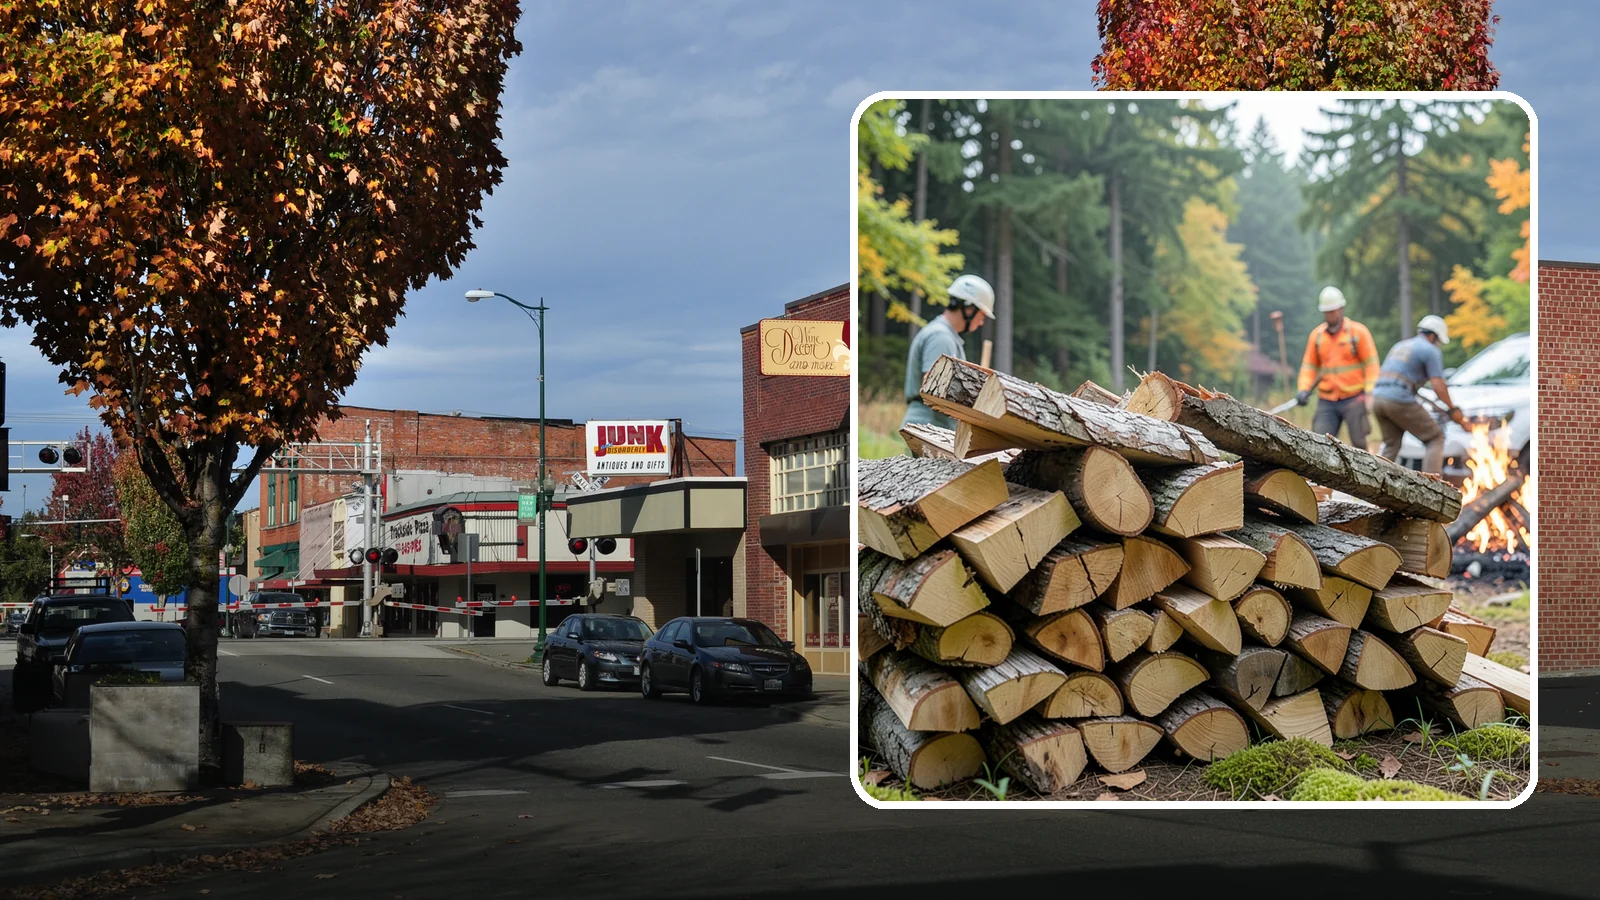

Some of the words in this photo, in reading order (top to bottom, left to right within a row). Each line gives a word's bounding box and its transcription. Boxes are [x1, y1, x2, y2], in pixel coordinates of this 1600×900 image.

[765, 328, 831, 366] Decor
[595, 425, 665, 457] JUNK
[607, 446, 646, 454] DISORDERLY
[596, 461, 628, 470] ANTIQUES
[631, 460, 644, 470] AND
[647, 460, 665, 470] GIFTS
[414, 519, 429, 535] Pizza
